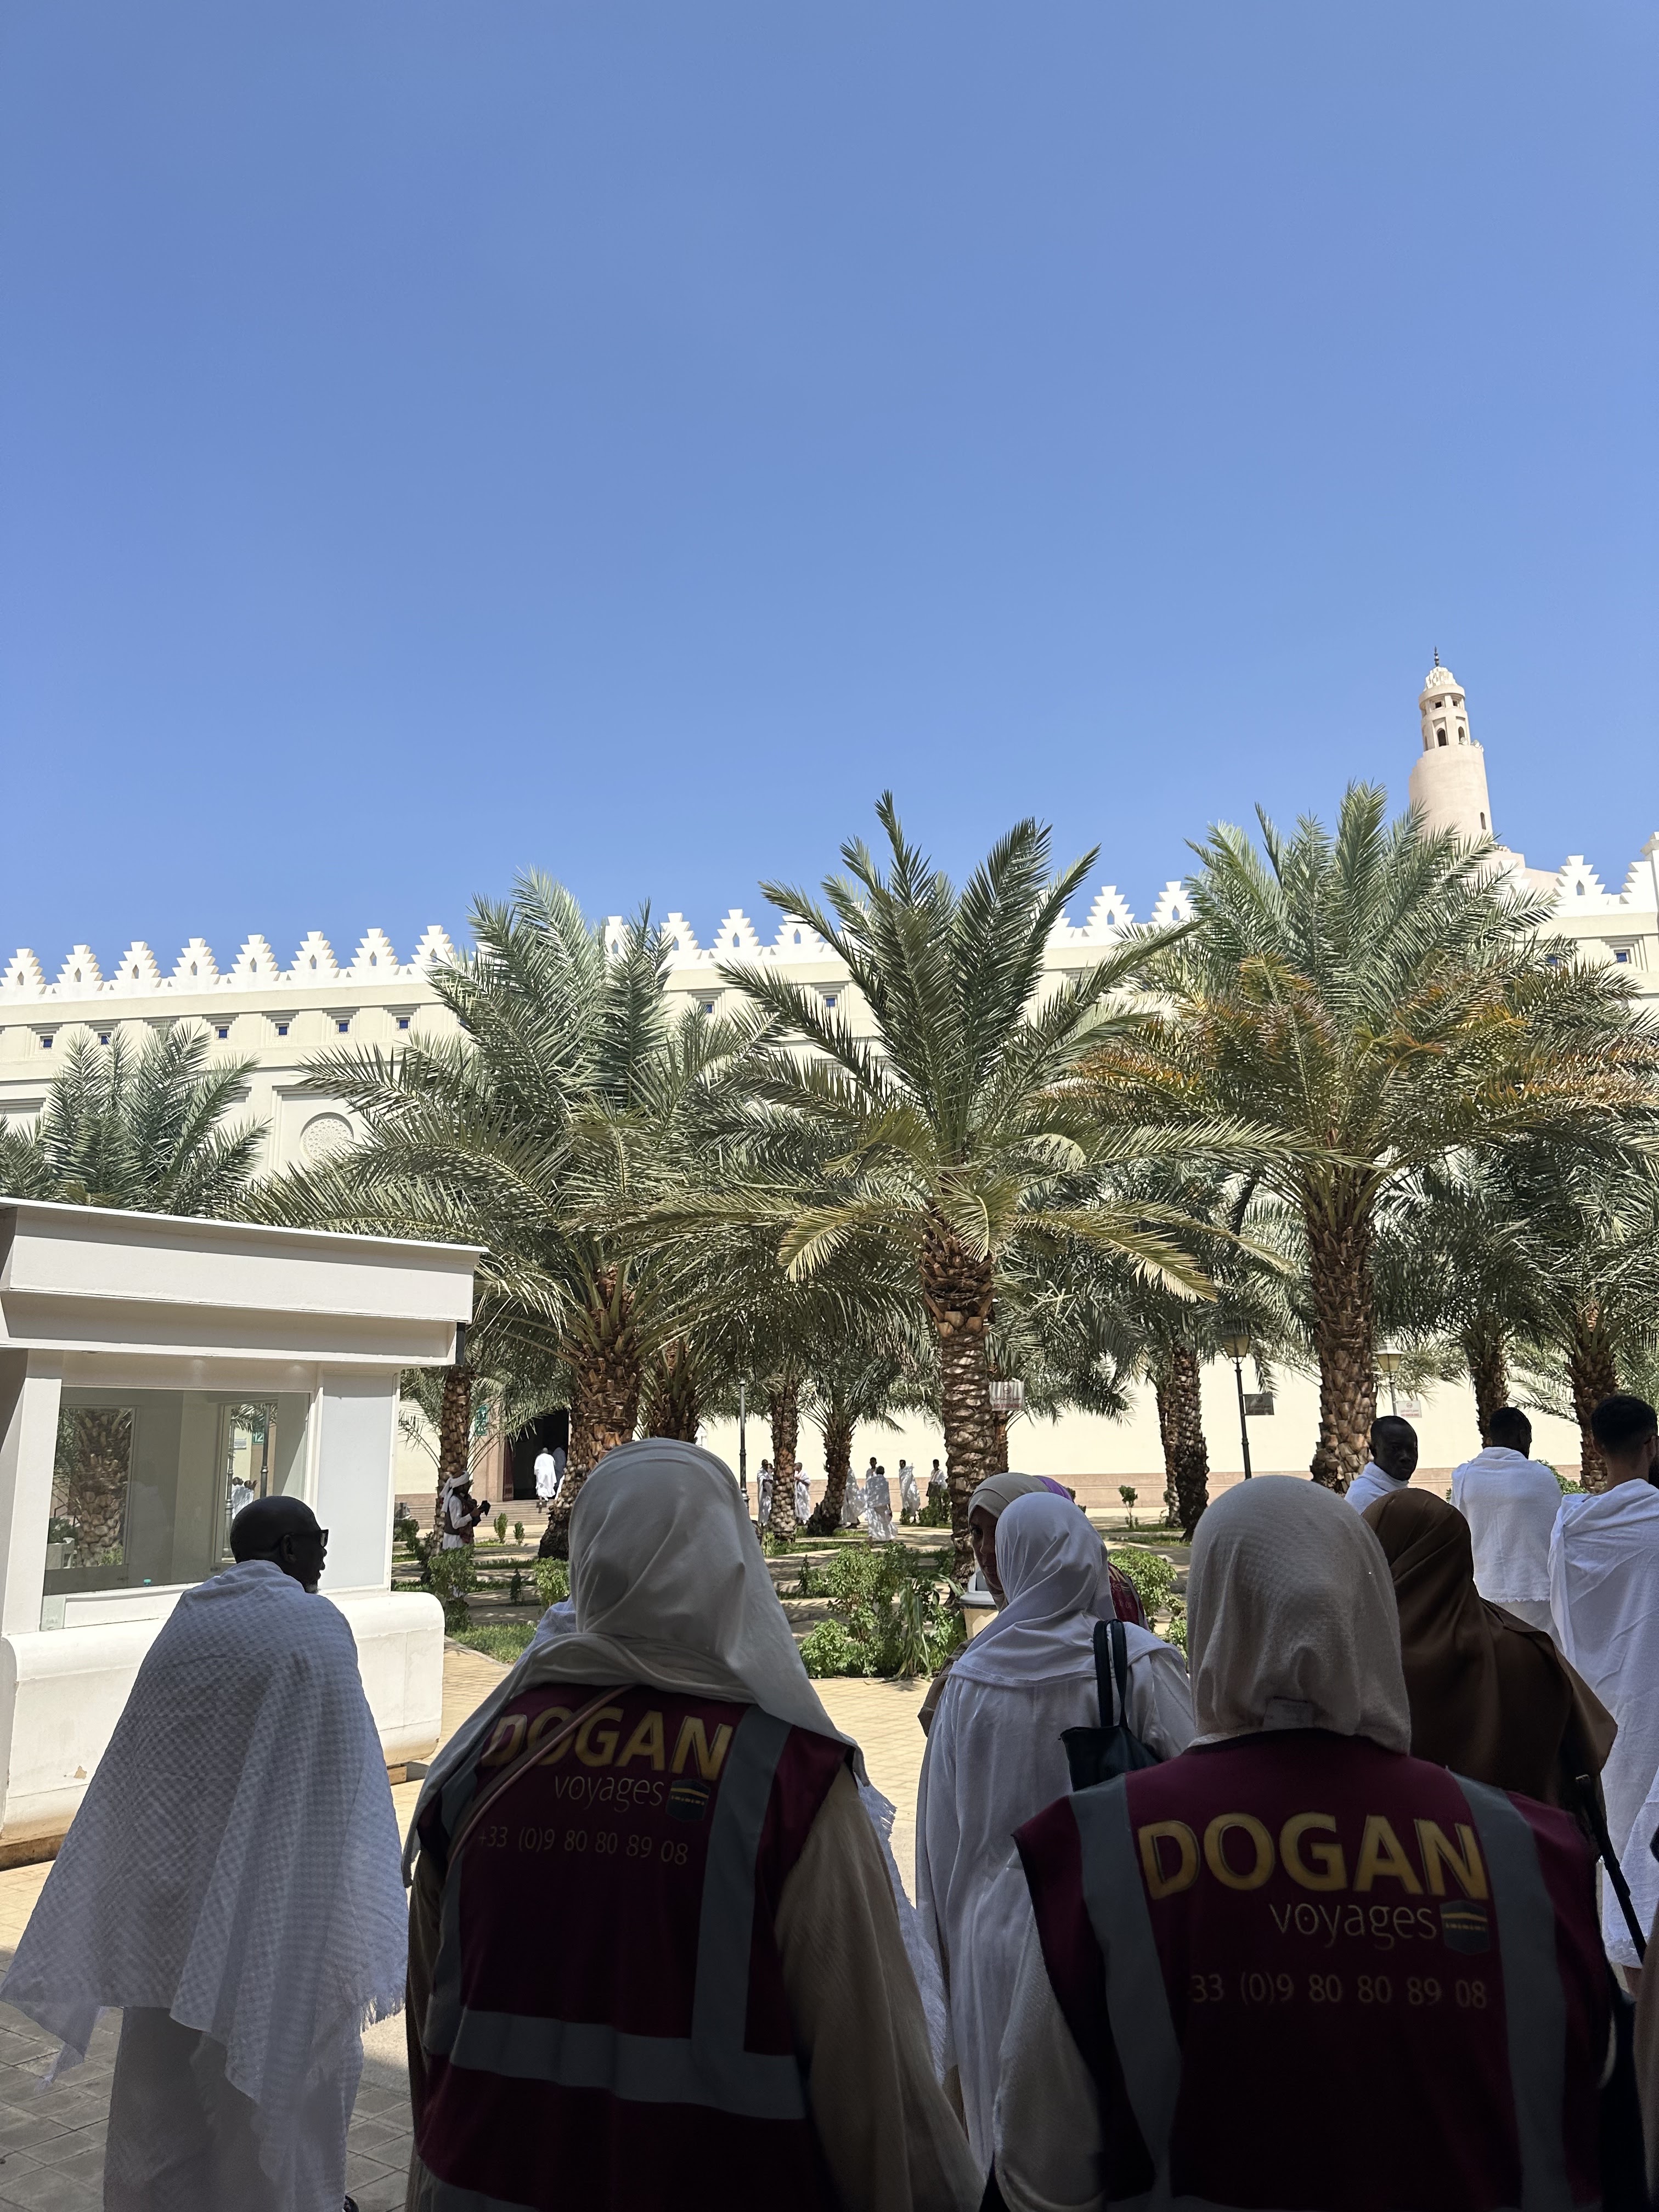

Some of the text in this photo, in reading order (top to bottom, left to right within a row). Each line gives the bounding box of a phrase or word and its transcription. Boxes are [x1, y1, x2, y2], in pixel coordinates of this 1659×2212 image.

[481, 1706, 733, 1781] DOGAN
[554, 1775, 665, 1813] voyages
[478, 1825, 689, 1865] +33 (0)9 80 80 89 08
[1137, 1812, 1489, 1900] DOGAN
[1269, 1902, 1437, 1951] voyages
[1240, 1971, 1295, 2006] (0)9
[1308, 1973, 1343, 2004] 80
[1357, 1974, 1393, 2004] 80
[1407, 1976, 1442, 2006] 89
[1455, 1978, 1488, 2010] 08
